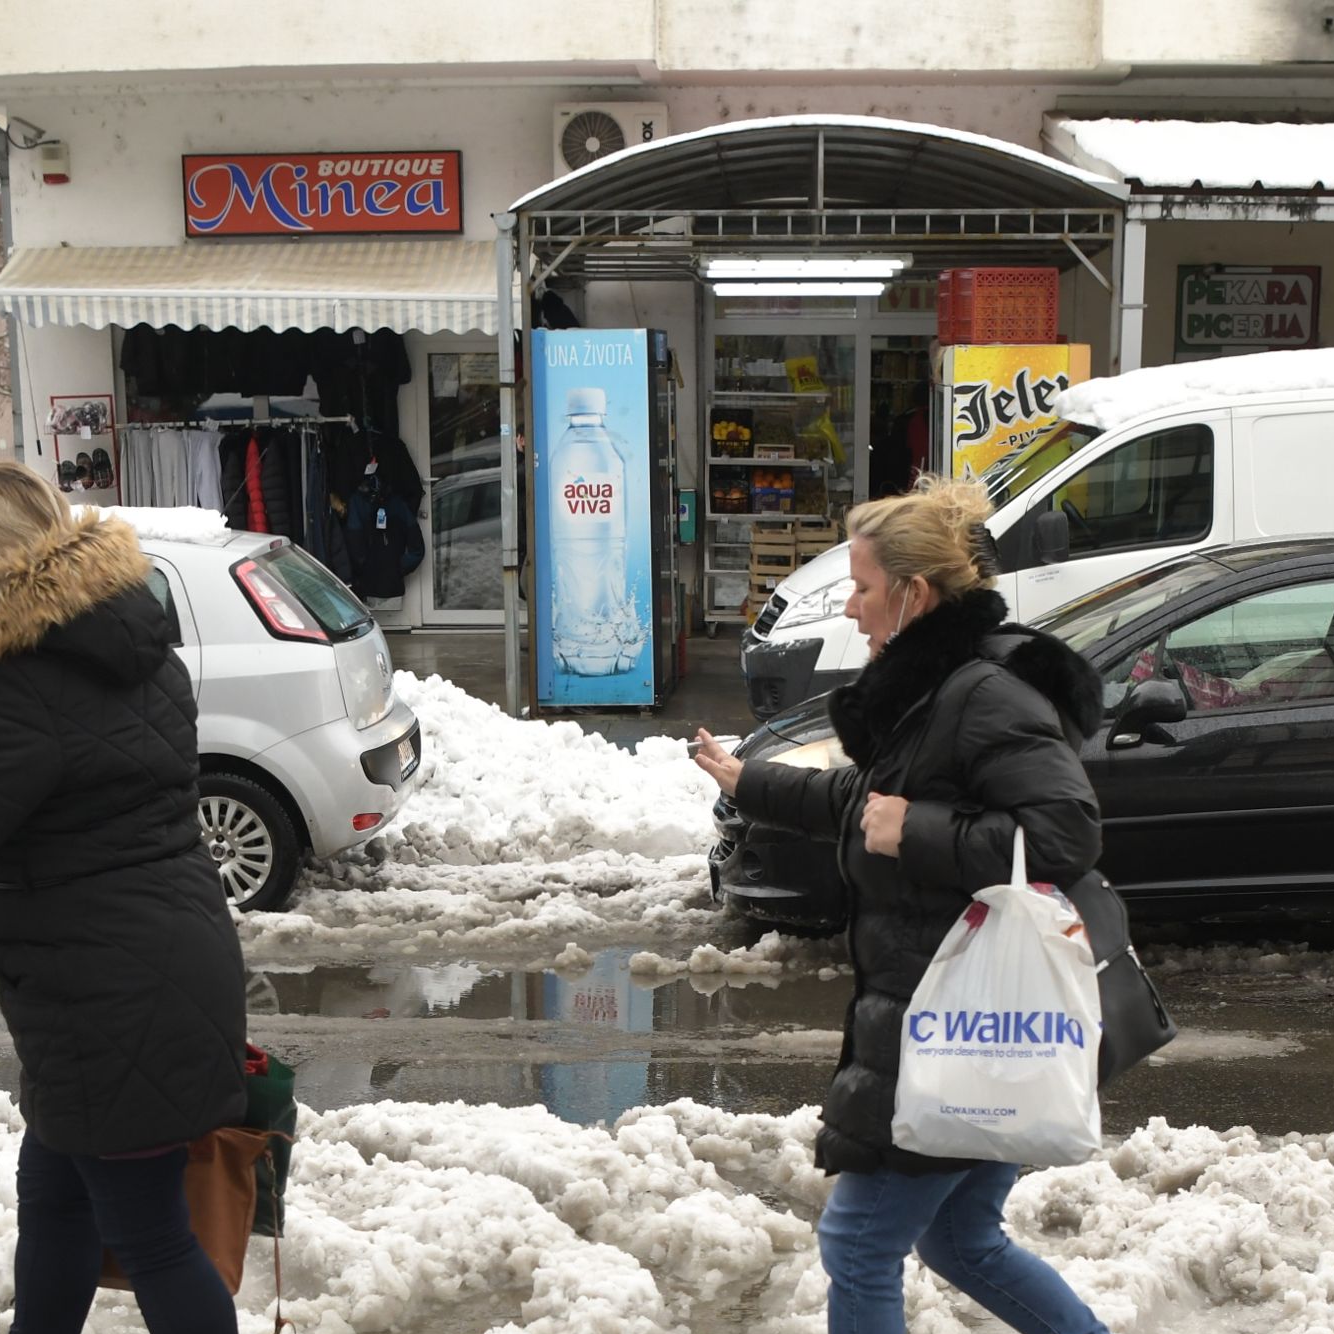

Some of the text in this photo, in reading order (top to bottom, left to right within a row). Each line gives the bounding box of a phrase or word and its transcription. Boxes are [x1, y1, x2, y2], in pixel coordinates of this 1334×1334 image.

[642, 121, 653, 142] OX
[317, 159, 445, 177] BOUTIQUE
[188, 162, 450, 231] Minea
[1186, 279, 1308, 306] PEKARA
[1186, 313, 1305, 339] PICERIJA
[545, 339, 634, 367] UNA ŽIVOTA
[564, 484, 613, 498] aqua
[567, 500, 611, 514] viva
[955, 1047, 994, 1057] deserves
[995, 1048, 1004, 1057] to
[1006, 1047, 1033, 1058] dress
[1036, 1047, 1056, 1058] well
[940, 1106, 1016, 1116] LCWAIKIKI.COM
